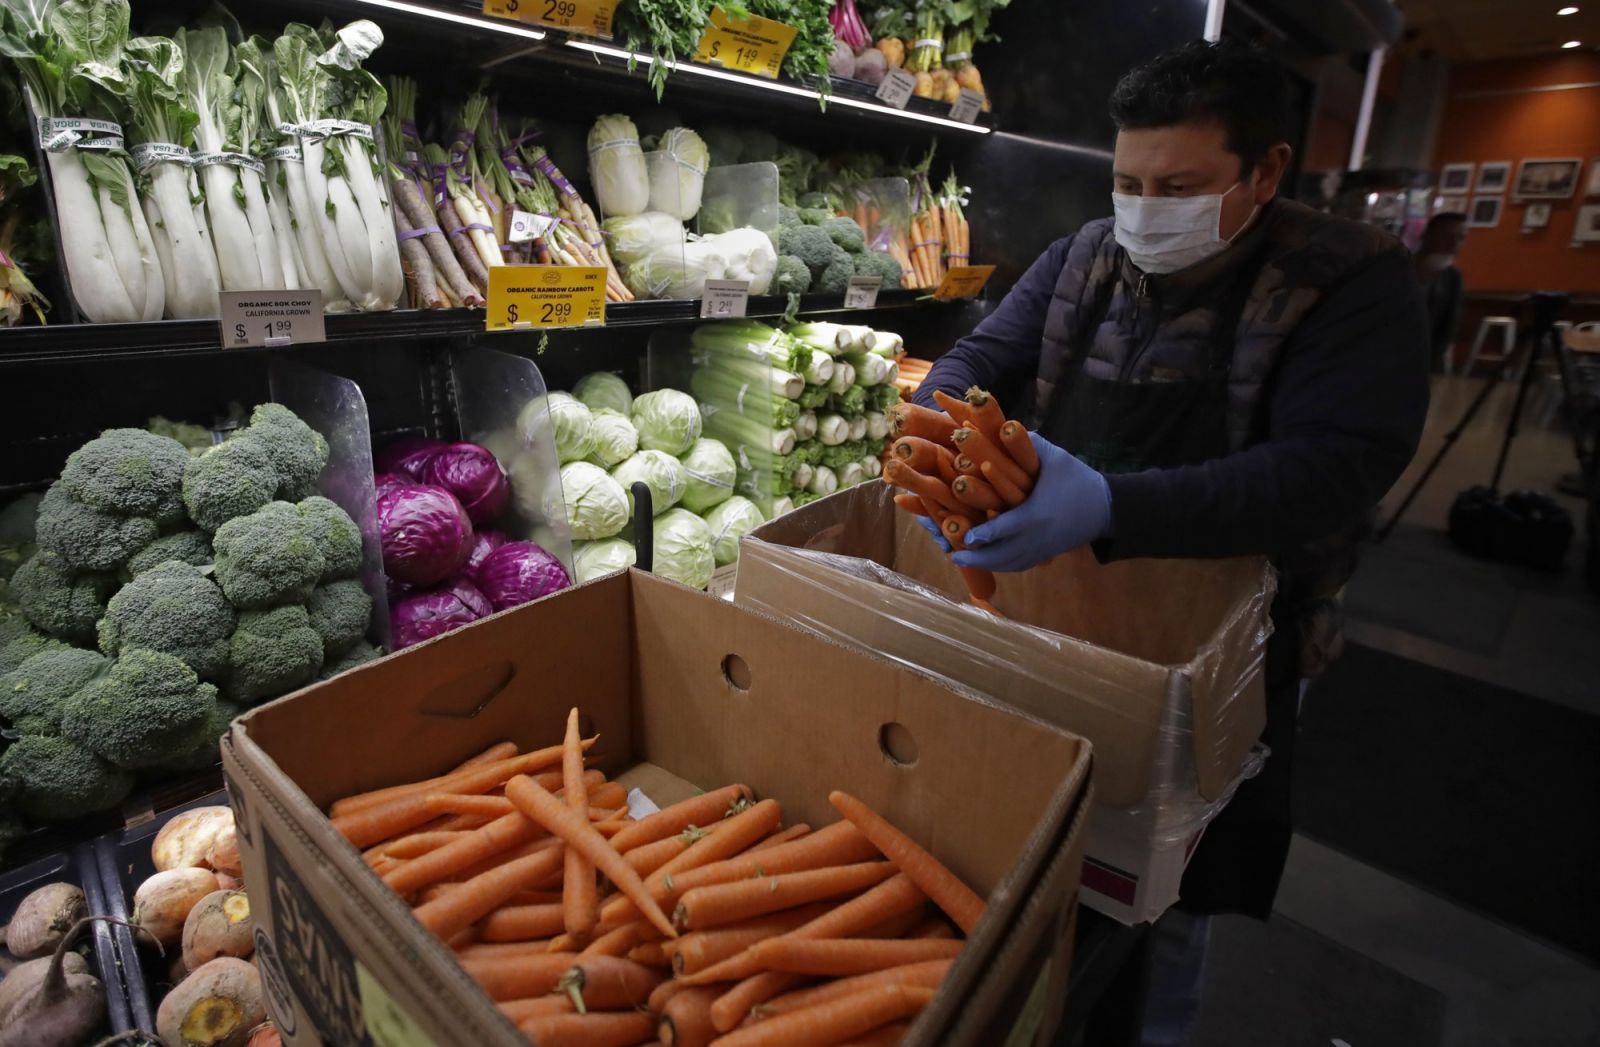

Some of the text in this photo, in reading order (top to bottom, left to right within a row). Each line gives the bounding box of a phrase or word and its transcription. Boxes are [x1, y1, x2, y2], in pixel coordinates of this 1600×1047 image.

[89, 121, 109, 129] USA
[152, 144, 171, 153] USA
[207, 155, 223, 163] USA
[506, 286, 536, 294] ORGANIC
[567, 285, 595, 293] CARROTS
[245, 308, 311, 318] CALIFORNIA GROWN
[507, 303, 519, 323] $
[234, 322, 247, 339] $
